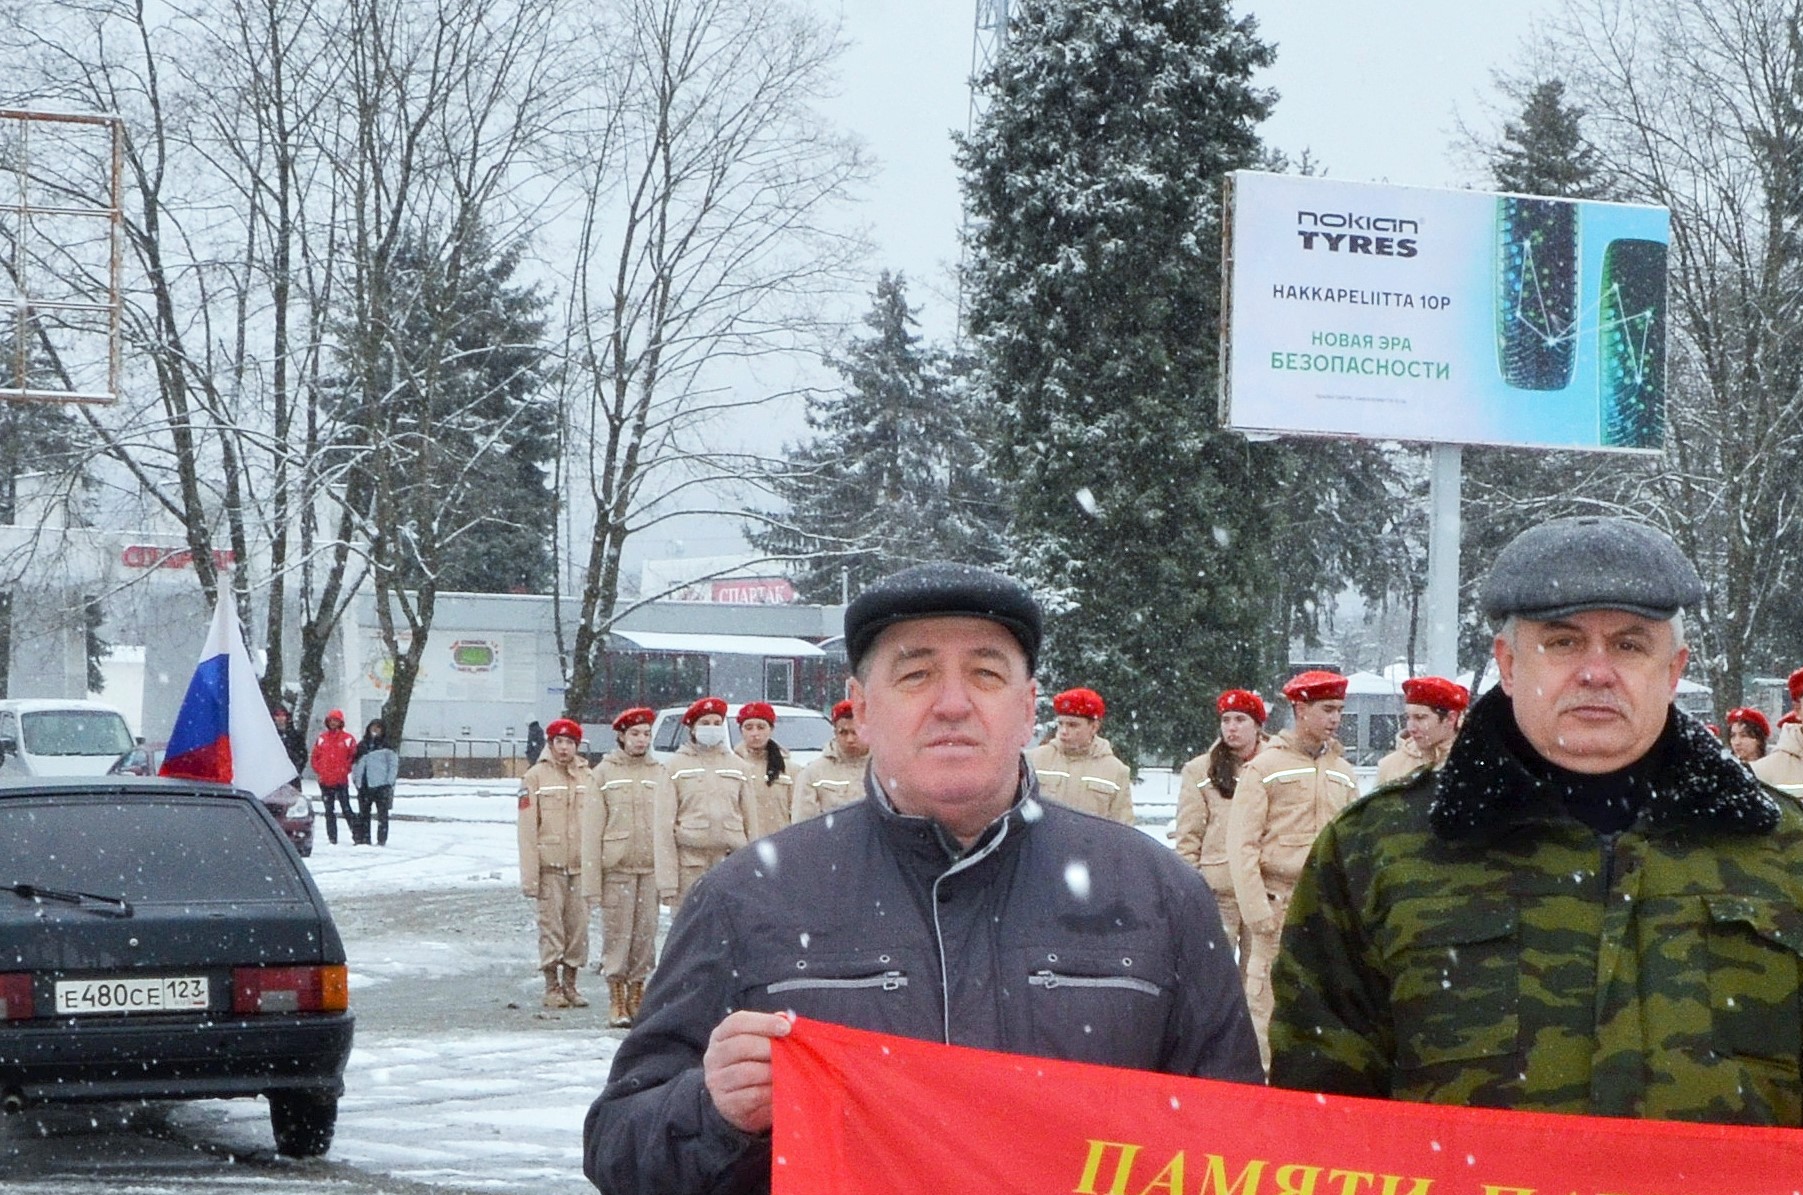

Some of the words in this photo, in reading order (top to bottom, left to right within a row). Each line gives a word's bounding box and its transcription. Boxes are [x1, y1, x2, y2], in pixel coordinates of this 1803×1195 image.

[1297, 230, 1418, 258] TYRES
[1273, 284, 1414, 308] HAKKAPELIITTA
[1420, 295, 1451, 310] 10P
[1311, 331, 1373, 349] НОВАЯ
[1378, 336, 1412, 351] ЭРА
[1271, 351, 1450, 380] БЕЗОПАСНОСТИ
[719, 585, 785, 604] СПАРТАК
[167, 980, 201, 998] 123
